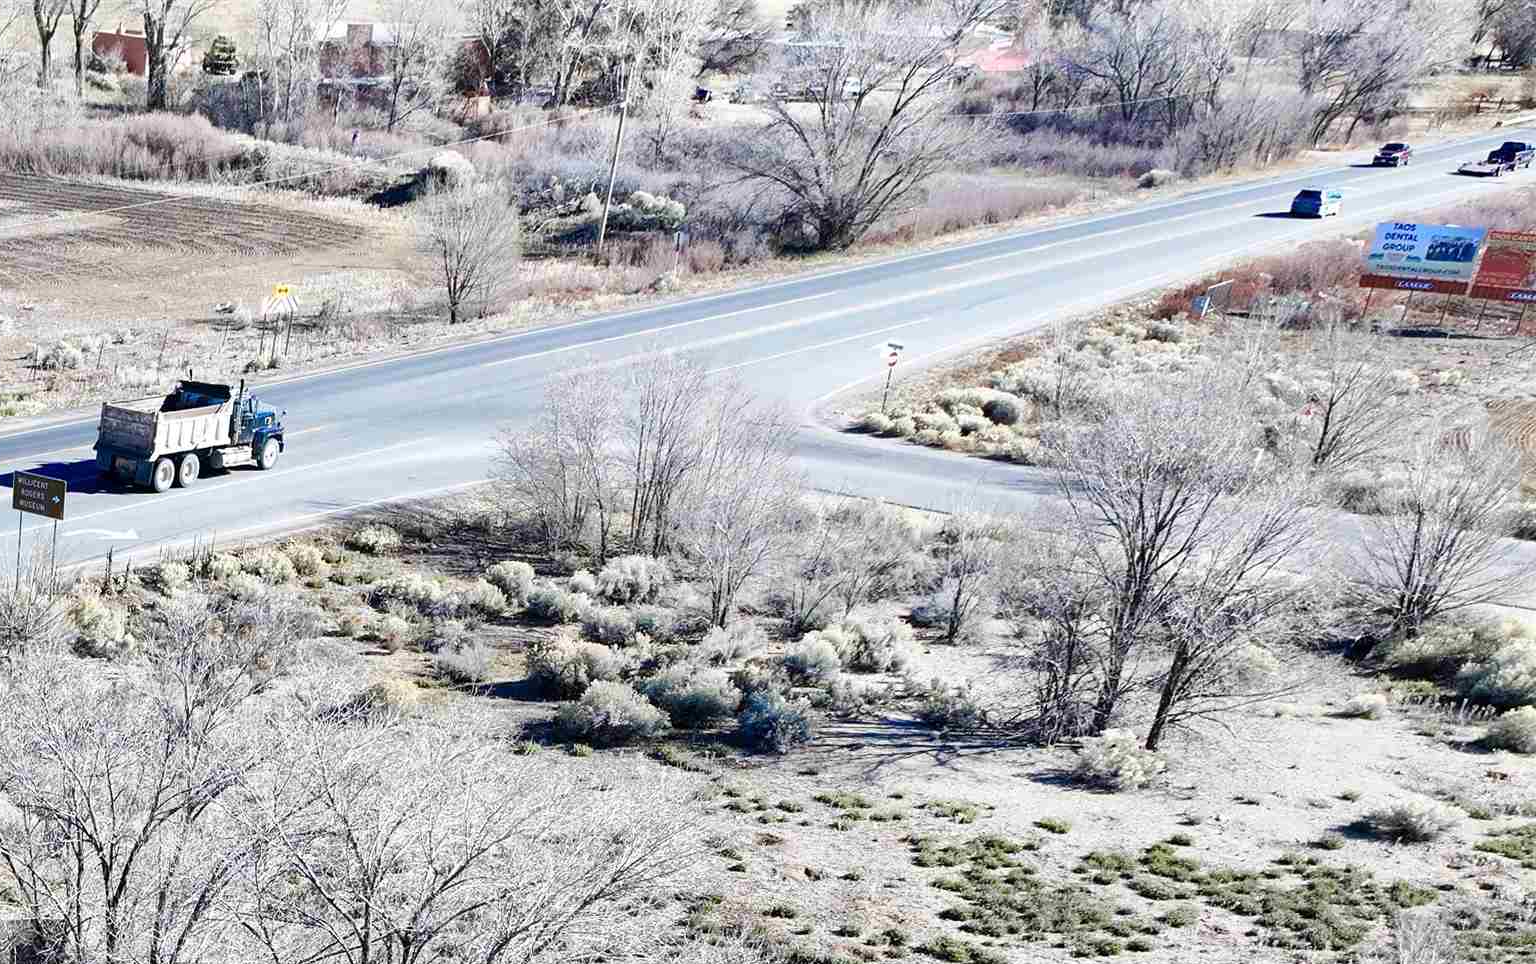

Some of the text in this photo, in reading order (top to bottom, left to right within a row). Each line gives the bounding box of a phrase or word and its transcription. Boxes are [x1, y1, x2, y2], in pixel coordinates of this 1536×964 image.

[1392, 223, 1417, 231] TAOS
[1384, 232, 1418, 241] DENTAL
[1382, 242, 1415, 251] GROUP
